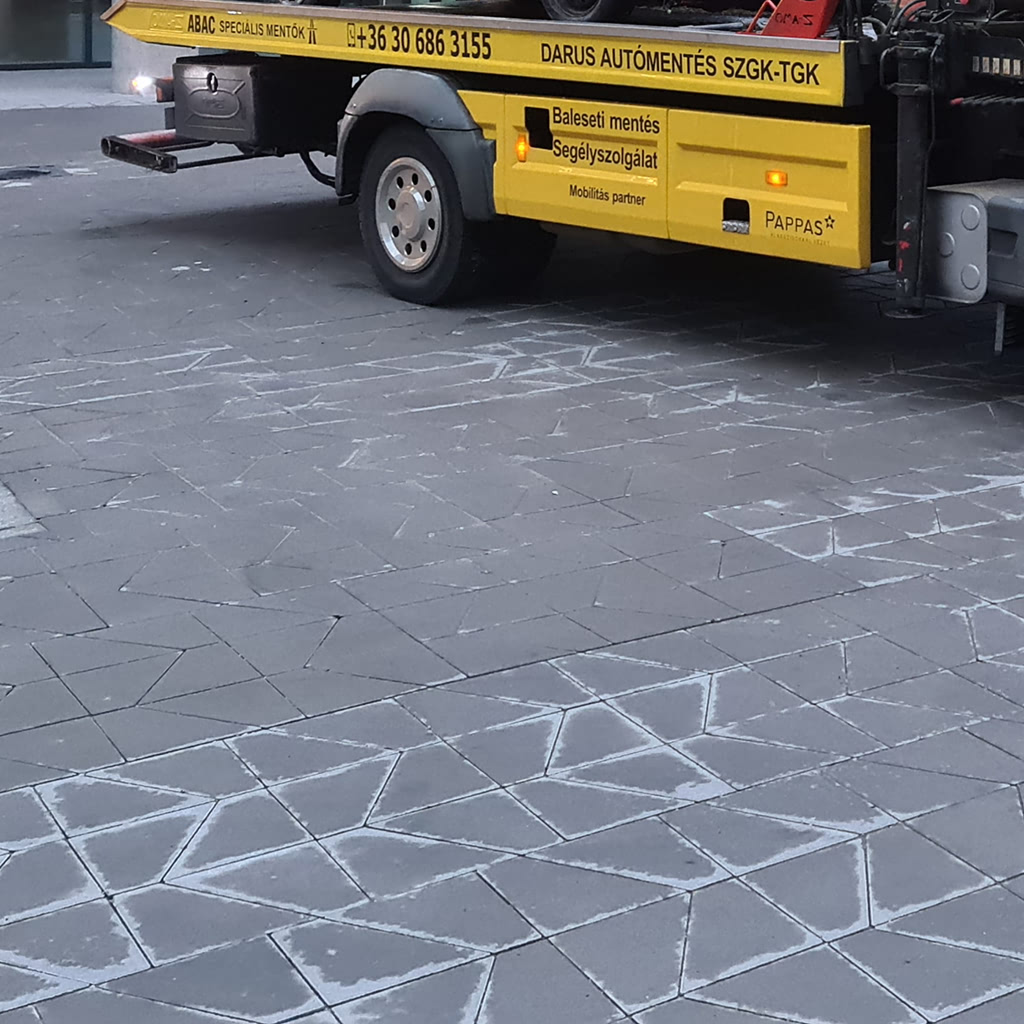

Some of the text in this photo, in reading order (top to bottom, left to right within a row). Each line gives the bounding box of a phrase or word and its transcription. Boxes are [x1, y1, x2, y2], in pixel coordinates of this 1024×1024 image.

[187, 14, 216, 35] ABAC
[219, 19, 264, 37] SPECIÁLIS
[357, 23, 492, 61] +36 30 686 3155
[541, 42, 820, 86] DARUS AUTÓMENTÉS SZGK-TGK
[552, 106, 660, 135] Baleseti mentés
[552, 139, 658, 171] Segélyszolgálat
[569, 184, 646, 207] Mobilitás partner
[765, 210, 823, 237] PAPPAS
